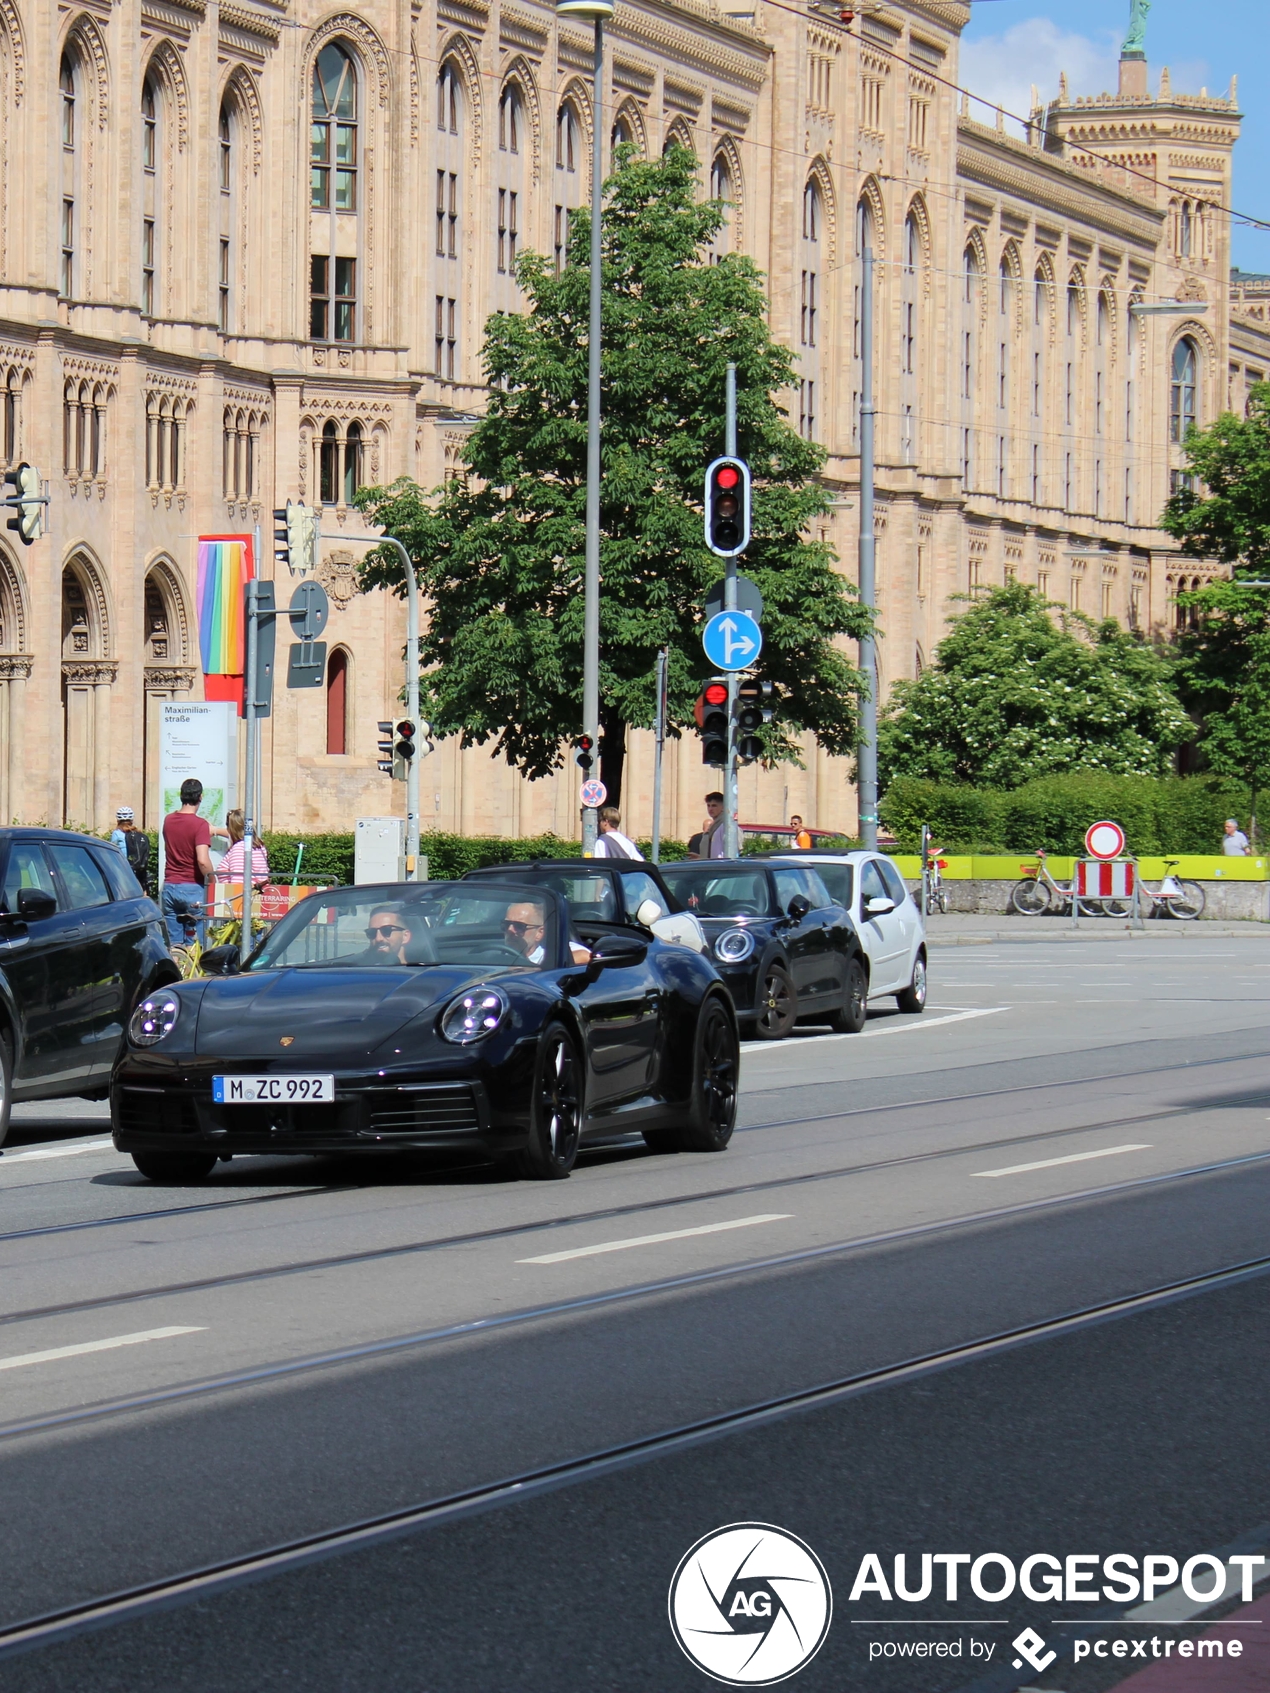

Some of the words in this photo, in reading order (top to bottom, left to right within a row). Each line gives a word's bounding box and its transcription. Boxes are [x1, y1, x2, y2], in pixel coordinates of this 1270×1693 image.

[164, 706, 211, 714] Maximilian-
[164, 715, 191, 723] straße
[230, 1080, 243, 1099] M
[256, 1080, 282, 1099] ZC
[286, 1080, 323, 1099] 992
